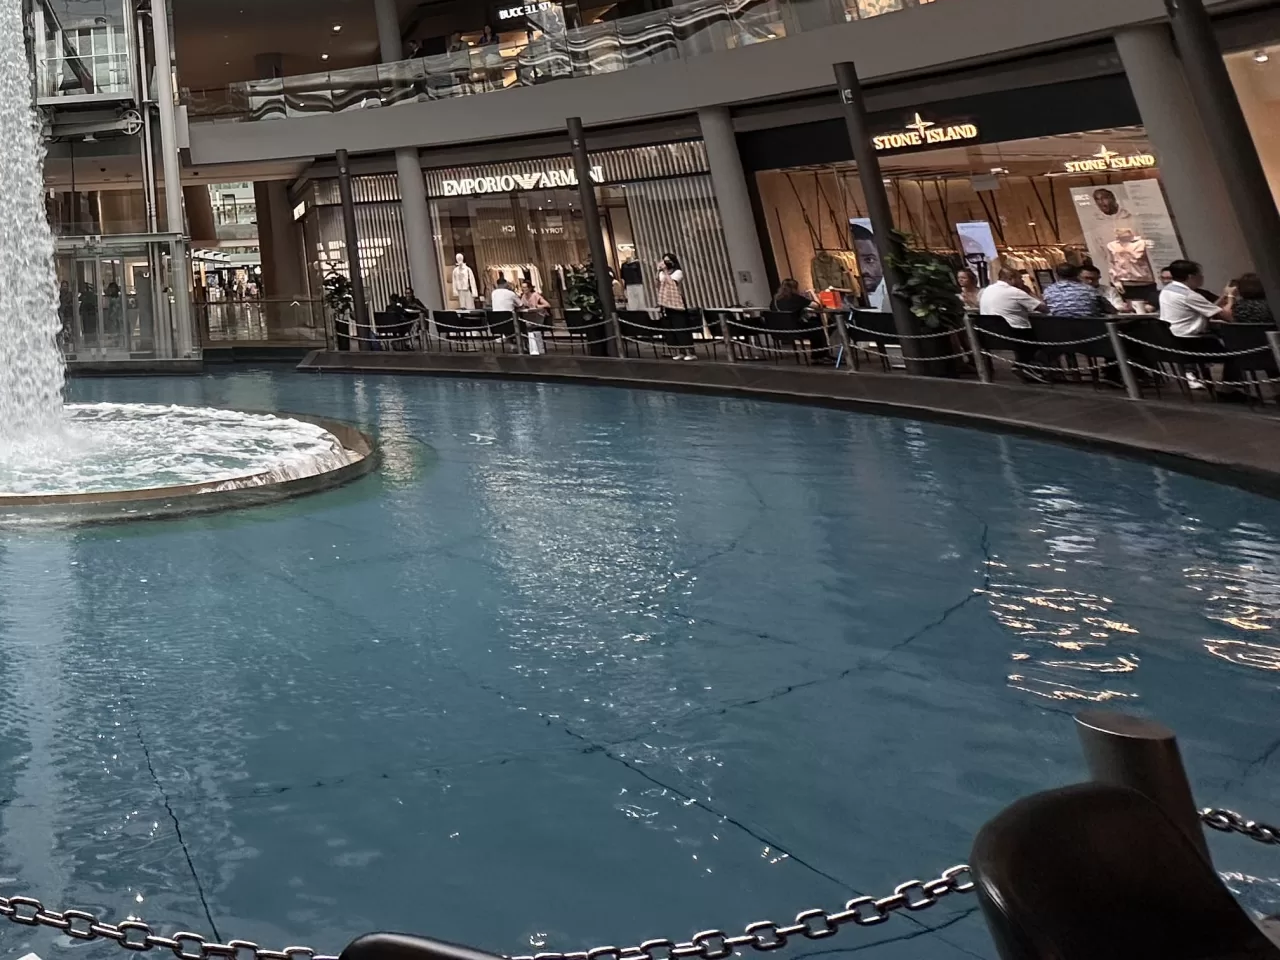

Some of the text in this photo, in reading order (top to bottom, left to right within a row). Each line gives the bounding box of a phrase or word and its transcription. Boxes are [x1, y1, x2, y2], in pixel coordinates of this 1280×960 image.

[872, 123, 978, 150] STONE ISLAND
[1064, 154, 1155, 172] STONE ISLAND
[442, 165, 605, 197] EMPORIO ARMNI
